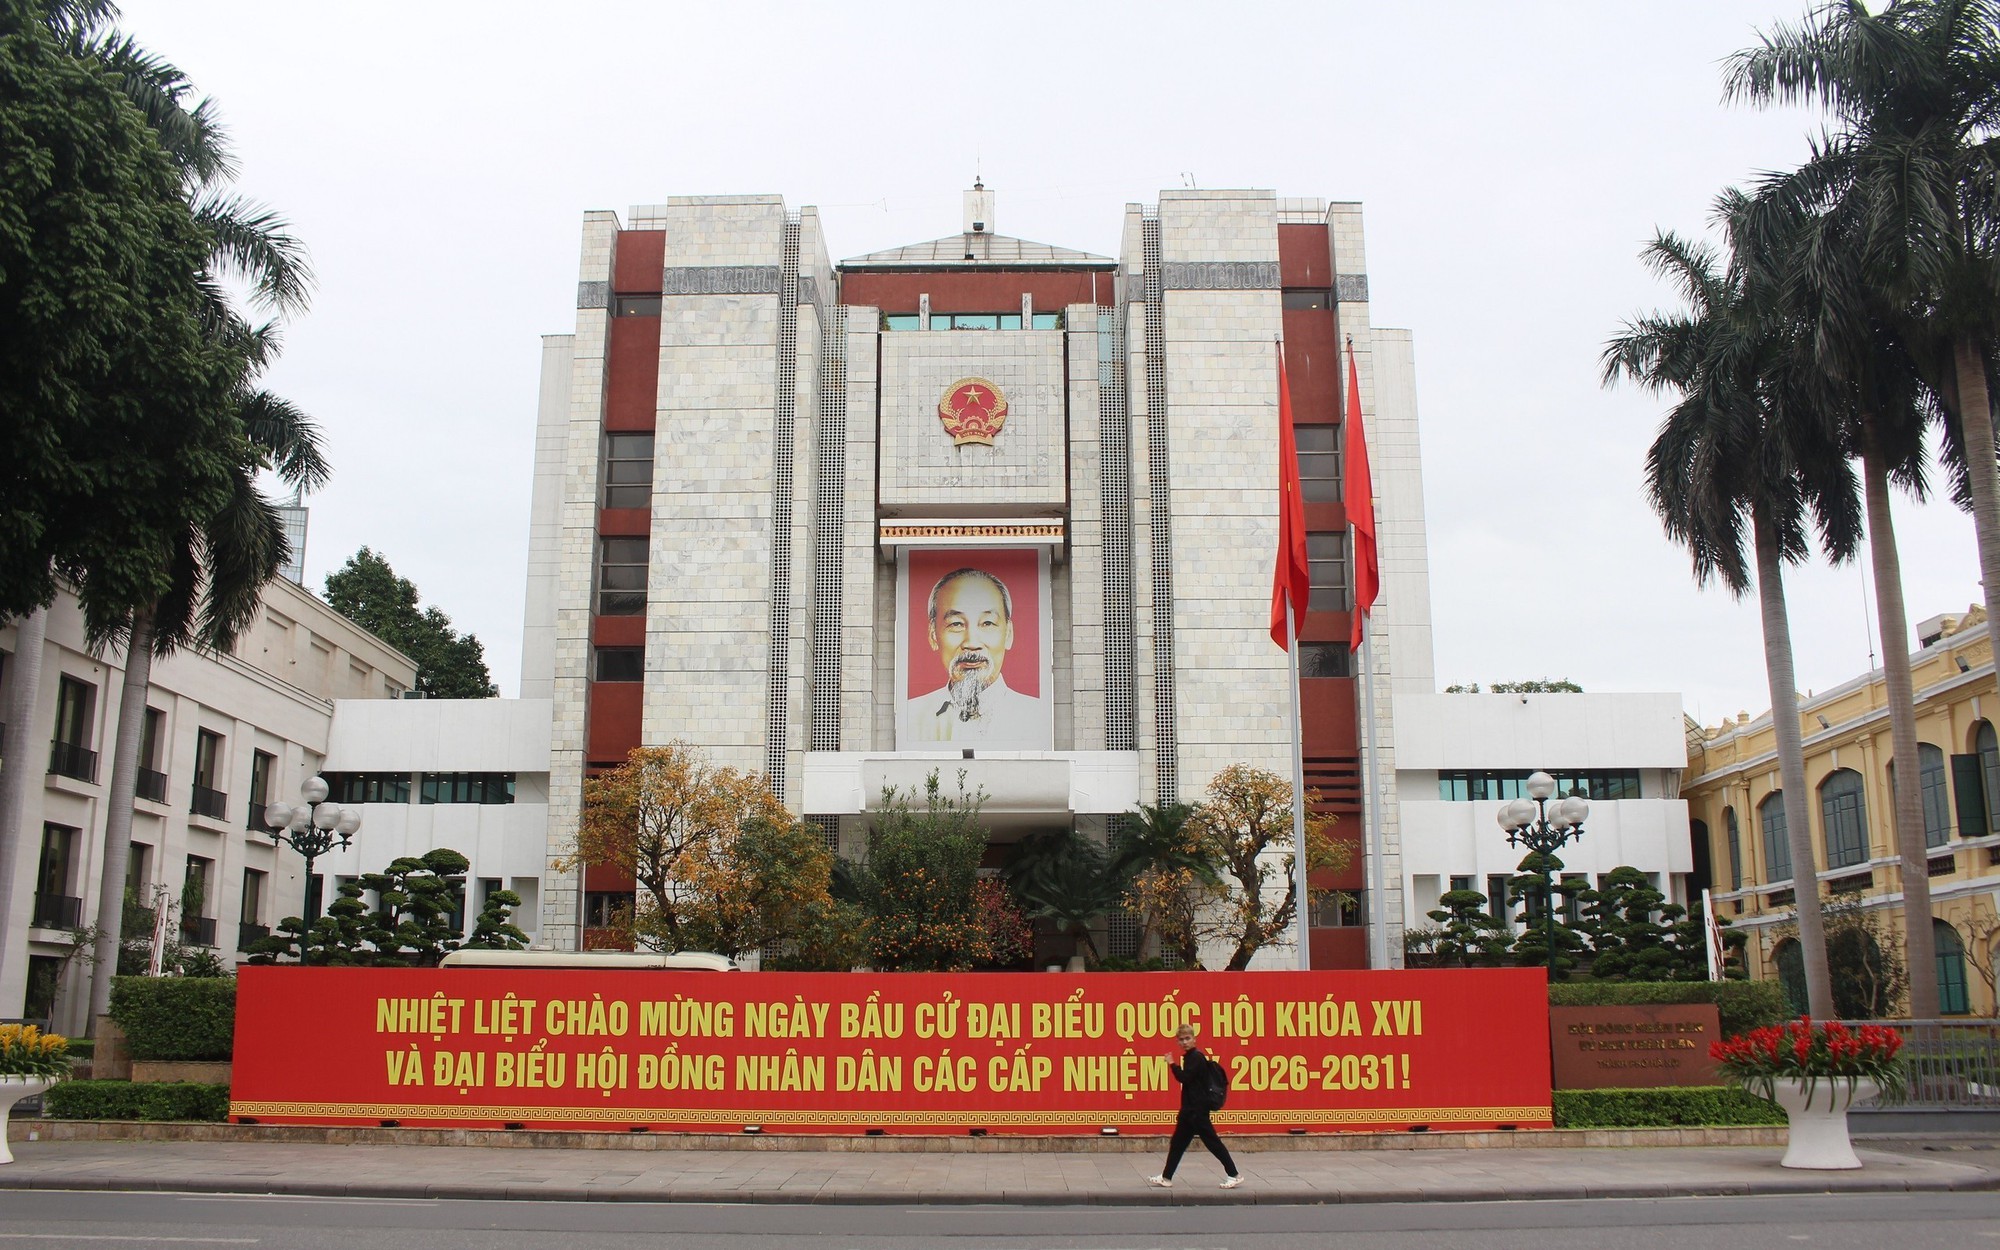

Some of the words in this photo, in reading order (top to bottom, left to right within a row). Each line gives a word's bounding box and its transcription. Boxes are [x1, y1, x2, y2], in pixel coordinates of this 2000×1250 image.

[376, 991, 465, 1042] NHIỆT
[473, 992, 537, 1043] LIỆT
[545, 992, 629, 1037] CHÀO
[639, 993, 734, 1039] MỪNG
[744, 994, 831, 1039] NGÀY
[840, 990, 904, 1039] BẦU
[915, 990, 961, 1040] CỬ
[966, 1002, 1021, 1047] ĐẠI
[1031, 987, 1105, 1039] BIỂU
[1115, 988, 1201, 1043] QUỐC
[1211, 993, 1265, 1046] HỘI
[1275, 993, 1363, 1038] KHÓA
[1371, 1000, 1423, 1037] XVI
[385, 1043, 425, 1086] VÀ
[433, 1051, 485, 1095] ĐẠI
[495, 1037, 566, 1089] BIỂU
[576, 1045, 628, 1097] HỘI
[637, 1042, 725, 1091] ĐỒNG
[735, 1047, 825, 1092] NHÂN
[836, 1048, 902, 1092] DÂN
[913, 1048, 977, 1093] CÁC
[988, 1043, 1053, 1092] CẤP
[1063, 1047, 1169, 1100] NHIỆM
[1230, 1053, 1411, 1091] 2026-2031!
